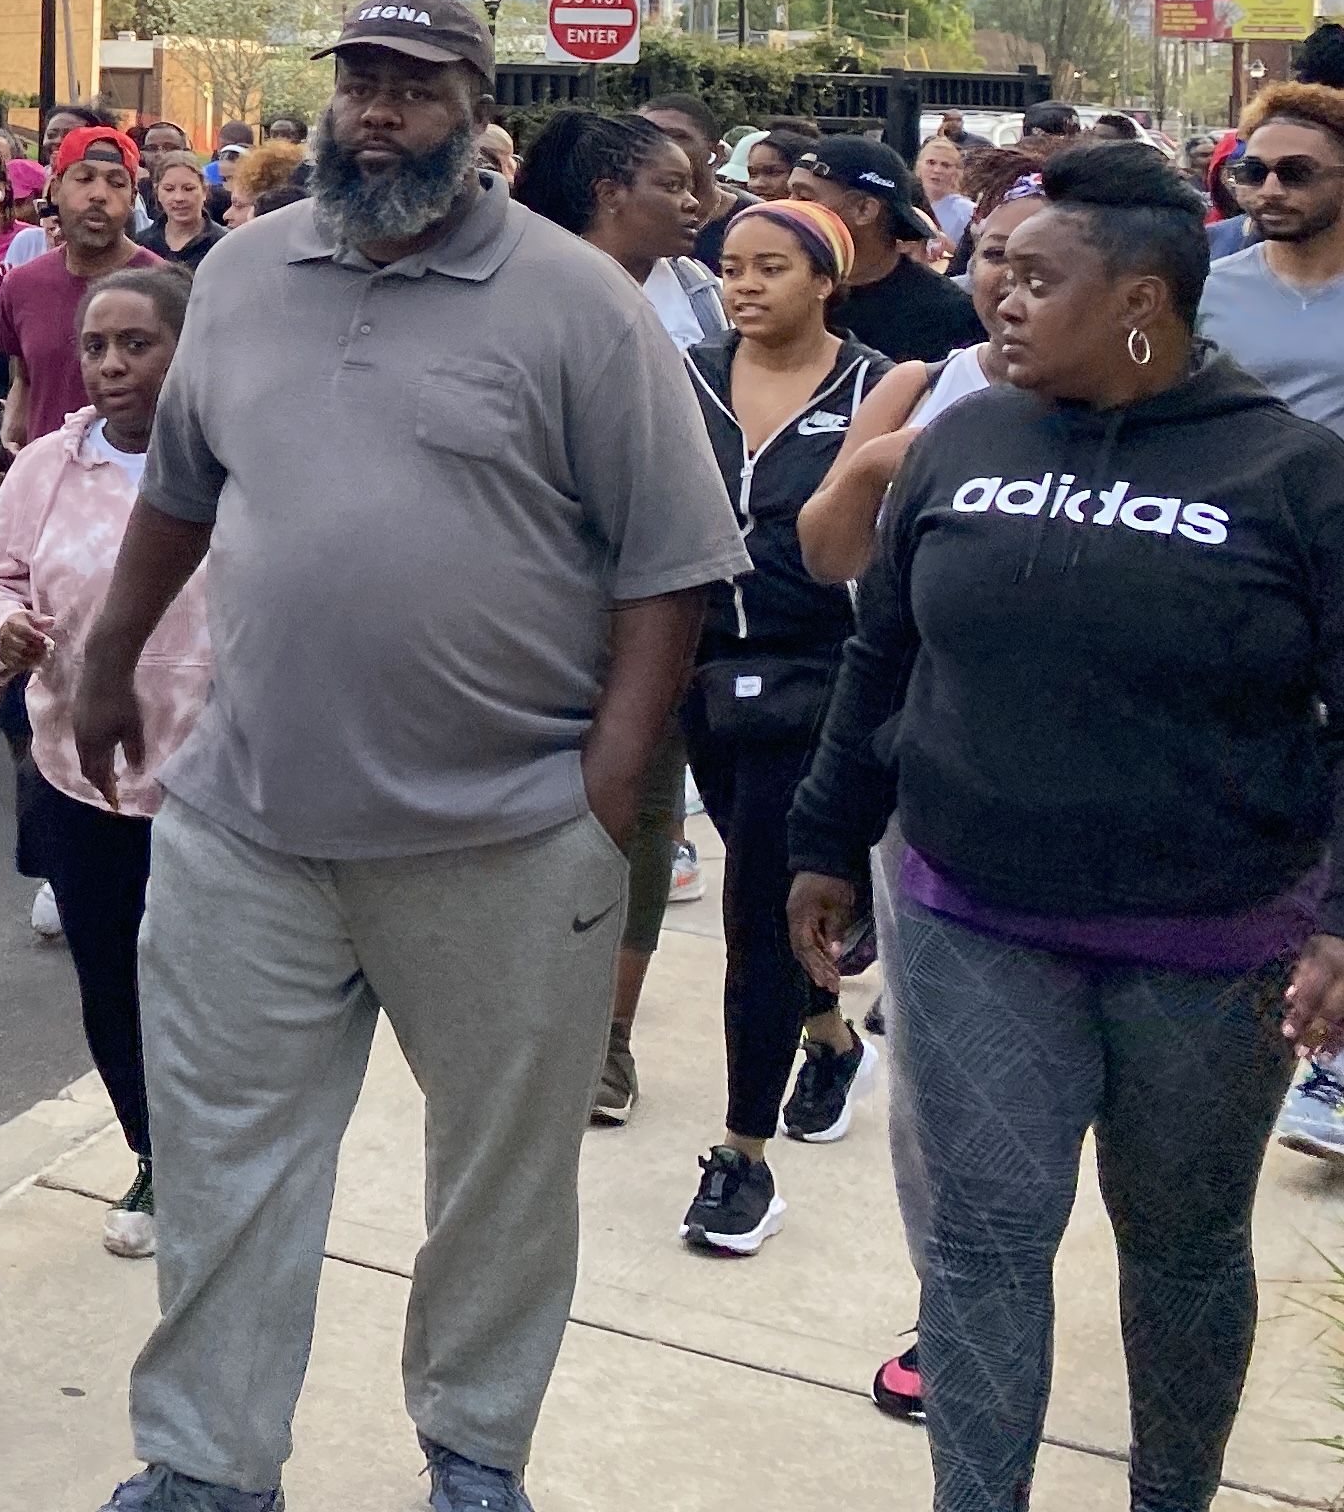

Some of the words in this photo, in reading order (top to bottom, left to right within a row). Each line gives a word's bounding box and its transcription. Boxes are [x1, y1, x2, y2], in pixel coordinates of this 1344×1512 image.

[358, 5, 432, 27] TEGNA
[567, 28, 618, 44] ENTER
[952, 472, 1230, 545] adidas
